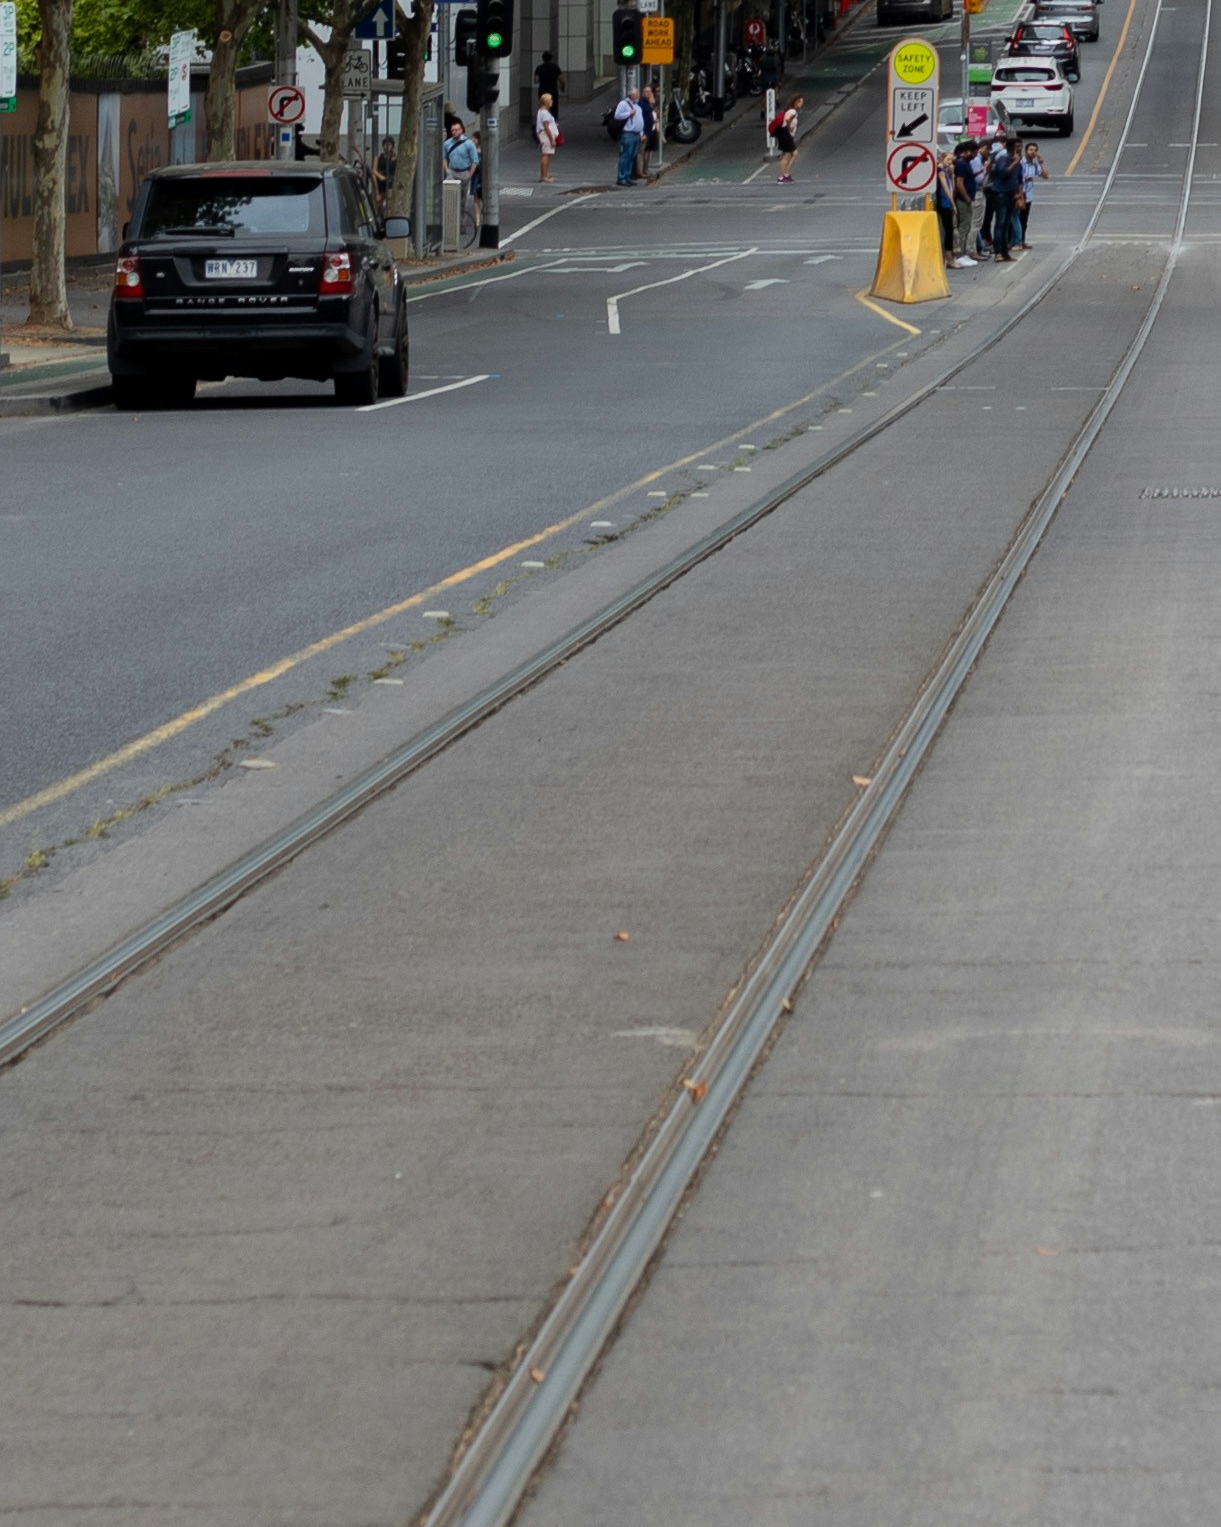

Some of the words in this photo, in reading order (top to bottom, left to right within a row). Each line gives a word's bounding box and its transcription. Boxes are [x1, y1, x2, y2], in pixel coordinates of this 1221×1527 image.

[897, 54, 931, 63] SAFETY
[902, 65, 925, 74] ZONE
[900, 92, 927, 100] KEEP
[900, 103, 925, 112] LEFT
[207, 261, 228, 274] WRN
[235, 261, 256, 274] 237
